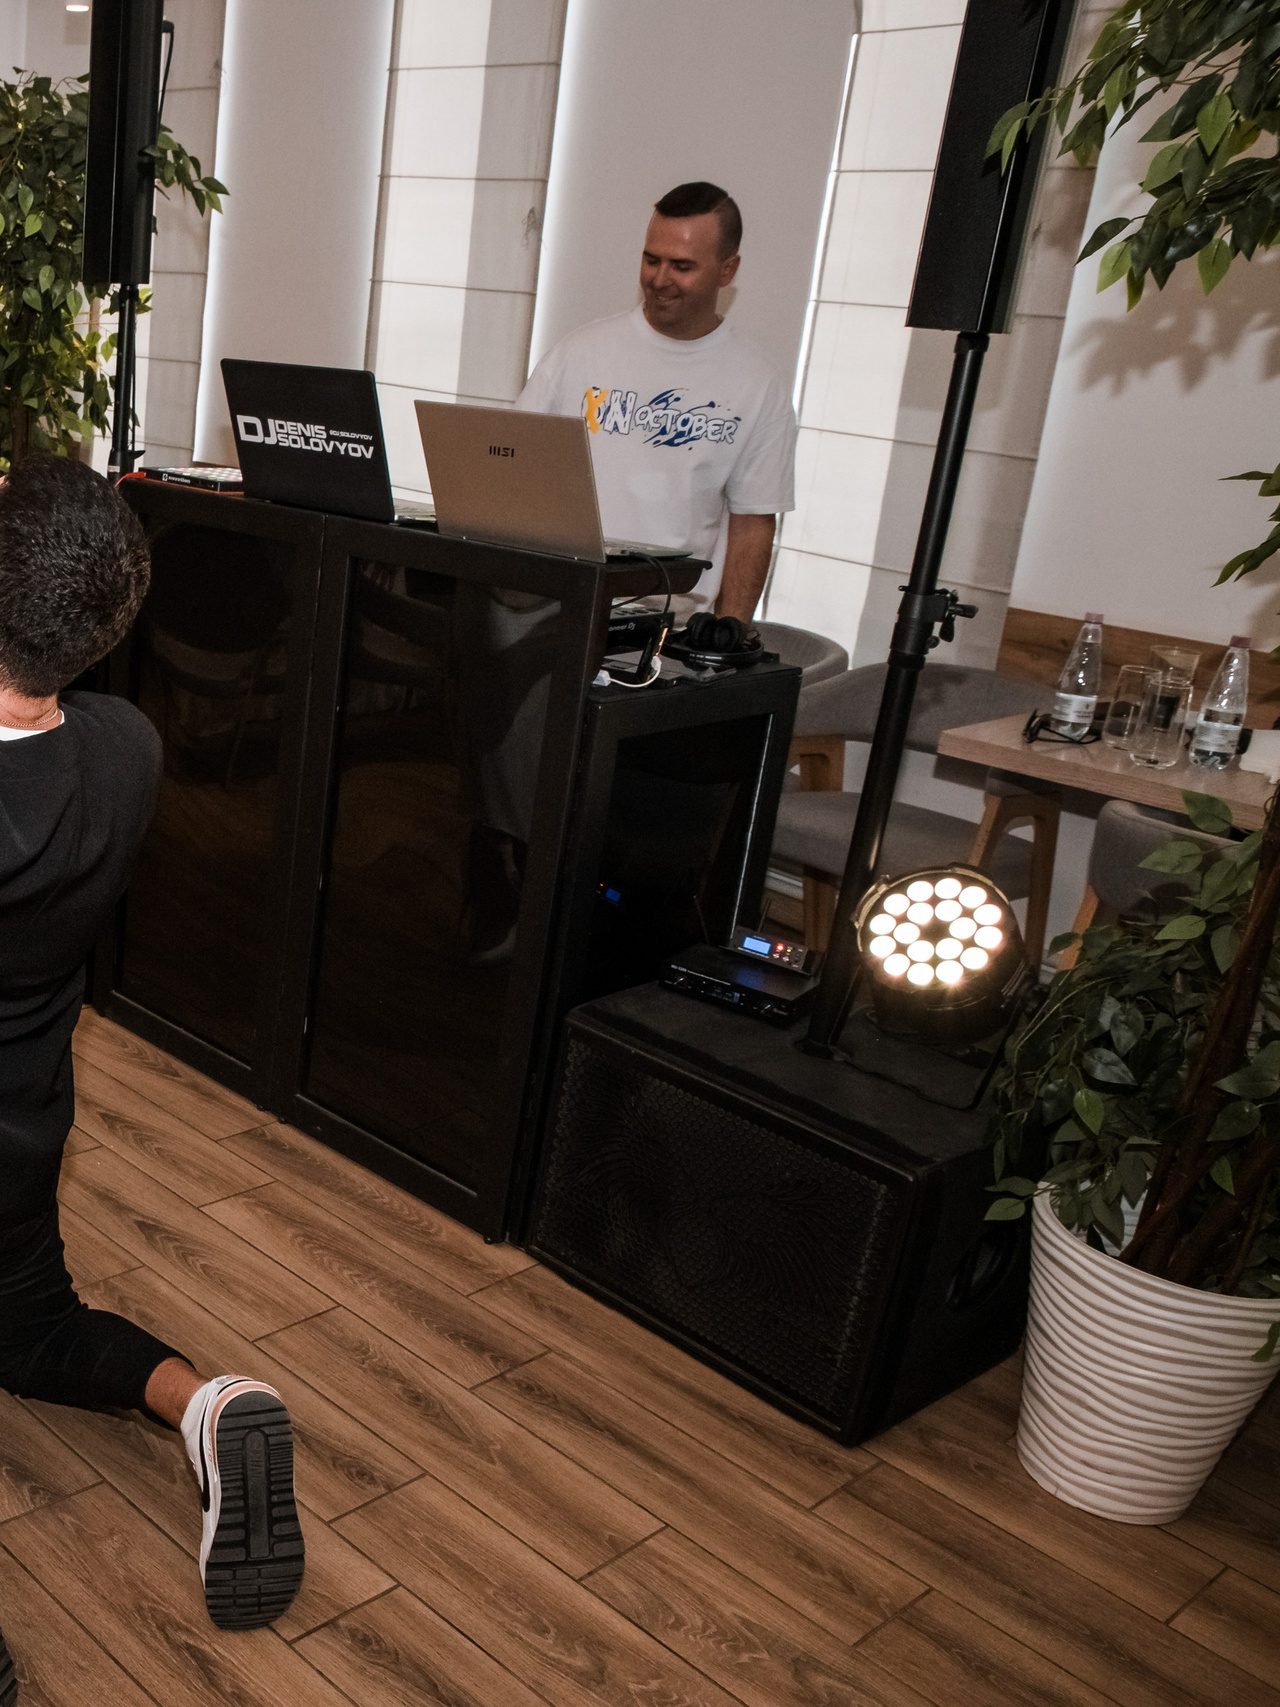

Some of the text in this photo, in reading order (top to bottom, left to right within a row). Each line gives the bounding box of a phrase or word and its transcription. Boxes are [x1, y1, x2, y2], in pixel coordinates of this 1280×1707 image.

[236, 414, 277, 445] DJ
[274, 419, 328, 439] DENIS
[634, 404, 739, 445] OCTOBER
[277, 433, 375, 459] SOLOVYOV
